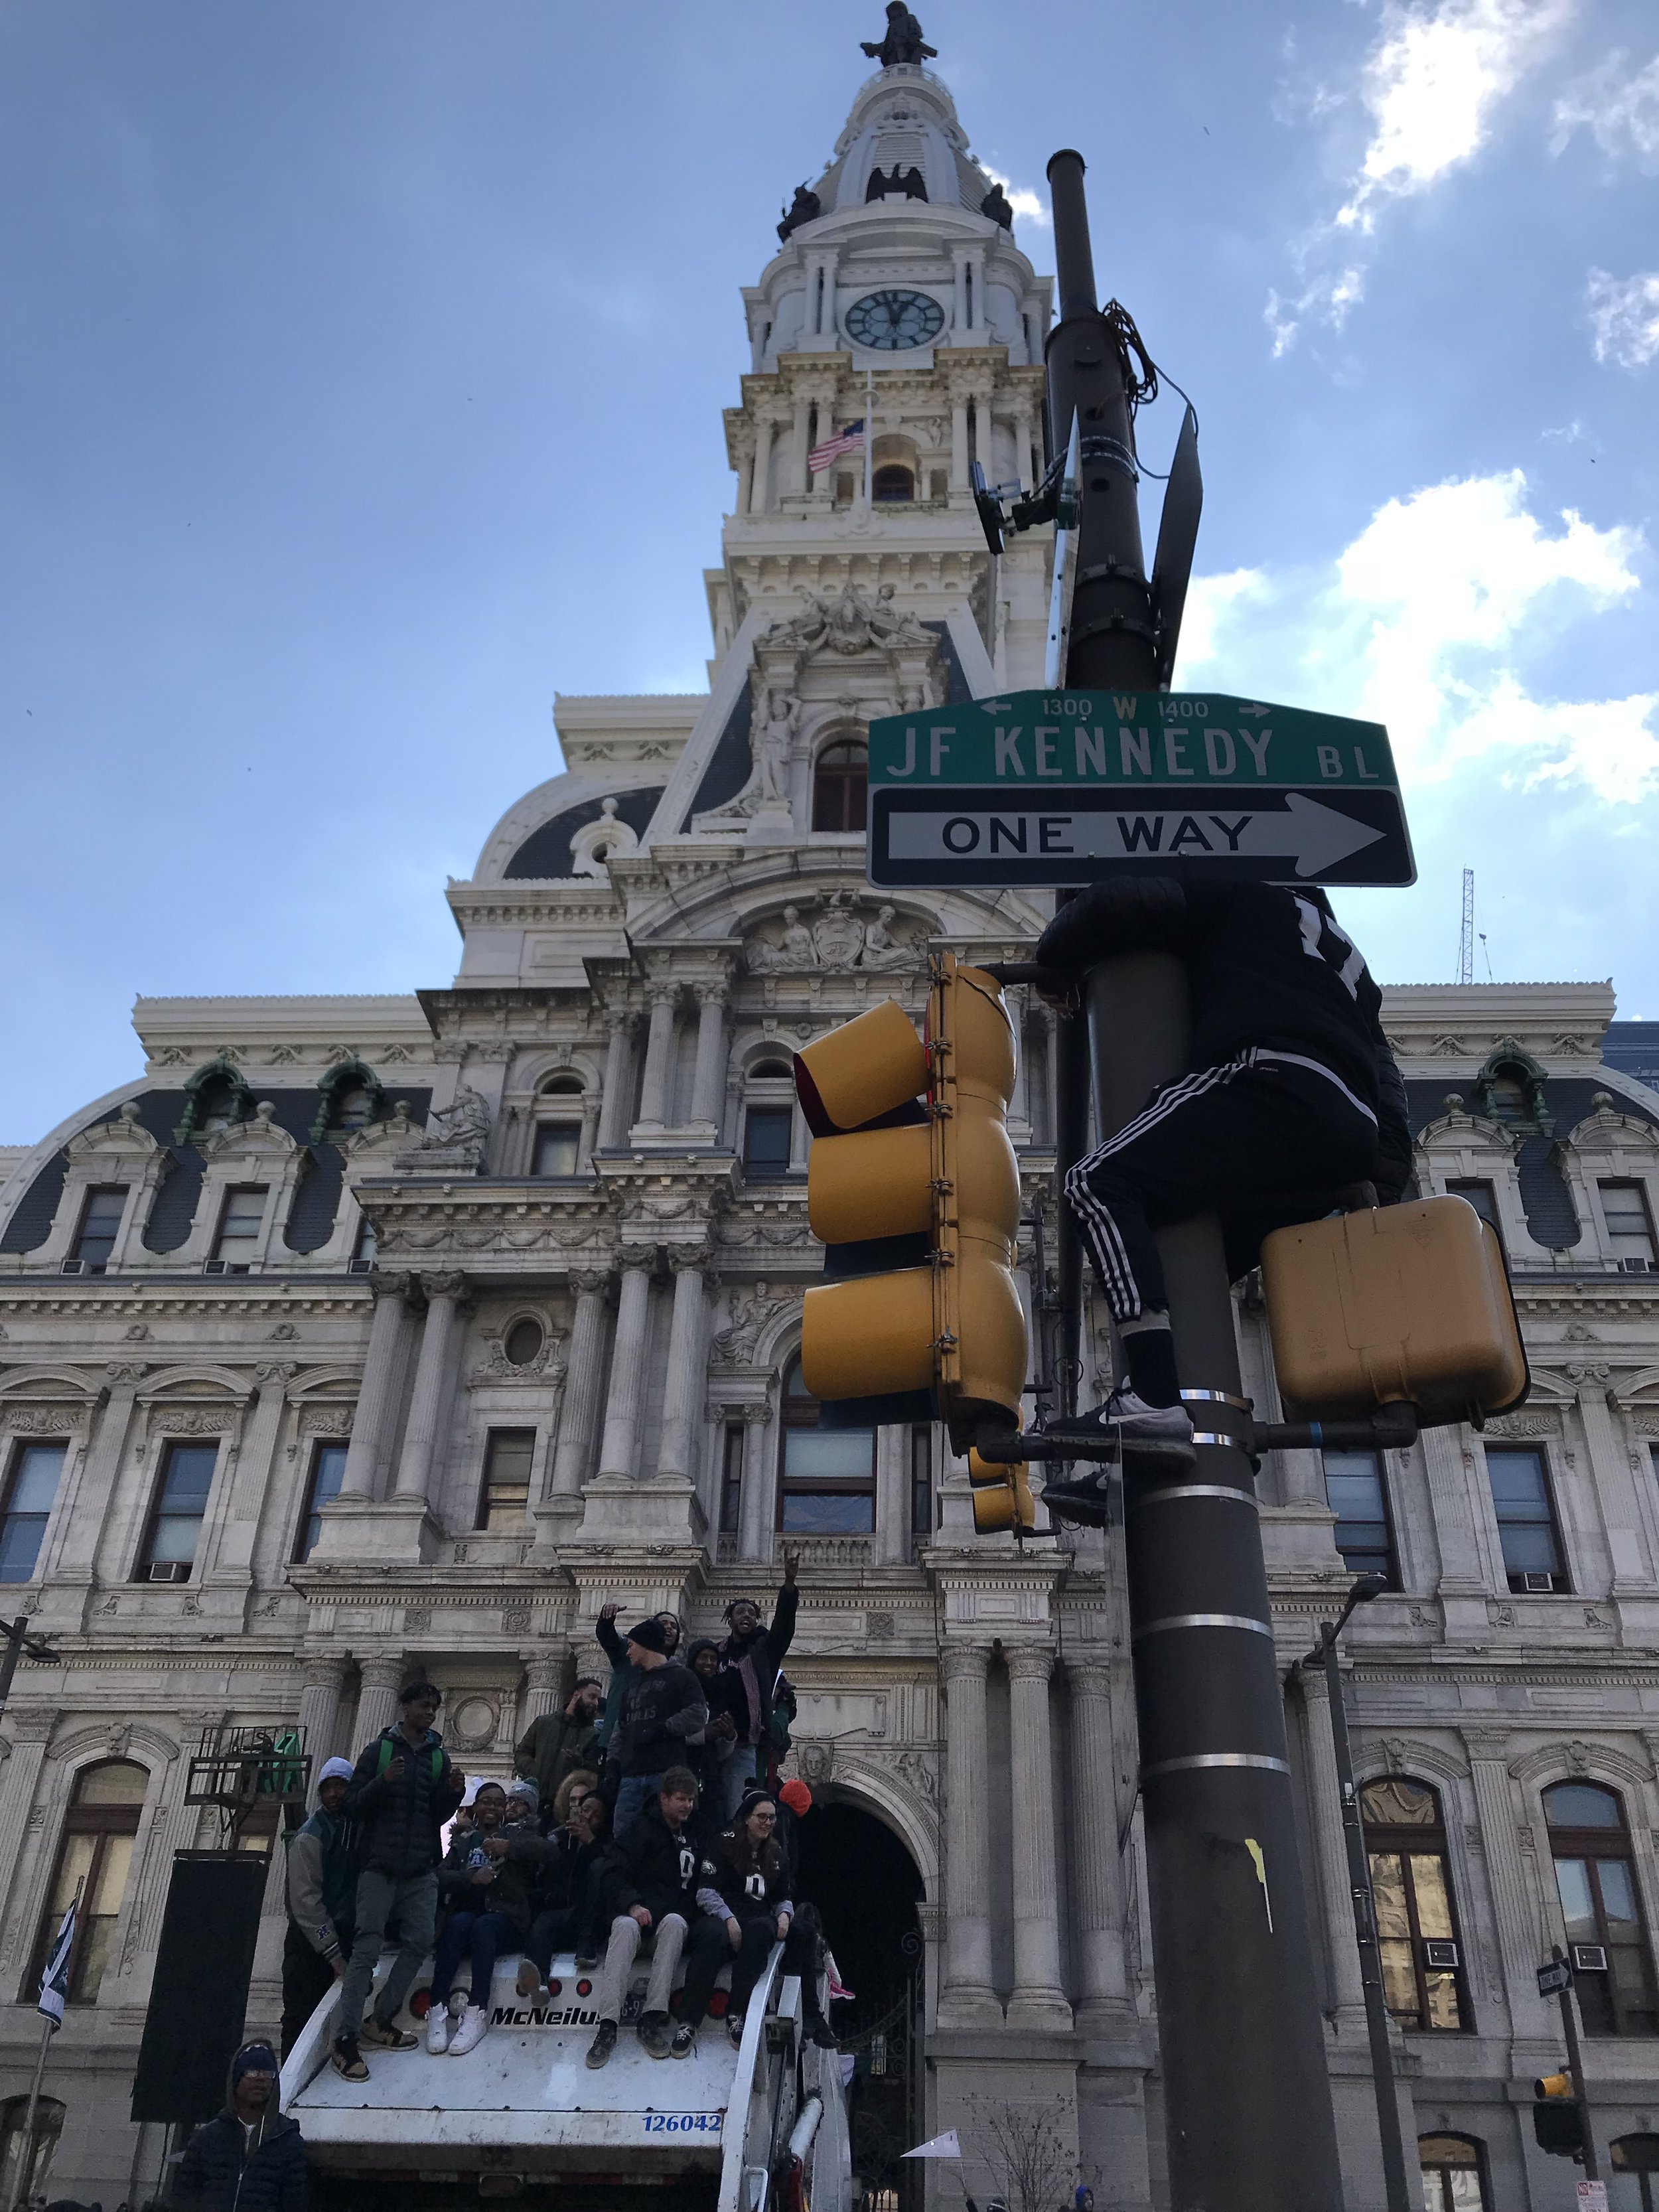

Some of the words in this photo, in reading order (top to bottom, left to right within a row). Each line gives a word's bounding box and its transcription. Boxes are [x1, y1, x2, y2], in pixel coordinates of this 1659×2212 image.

[1041, 698, 1093, 716] 1300
[1112, 696, 1137, 720] W
[1158, 701, 1209, 718] 1400
[886, 727, 956, 776] JF
[995, 726, 1273, 776] KENNEDY
[1317, 745, 1380, 779] BL
[942, 816, 1074, 854] ONE
[1116, 816, 1253, 852] WAY
[490, 2007, 601, 2026] McNeilu
[642, 2114, 721, 2132] 126042
